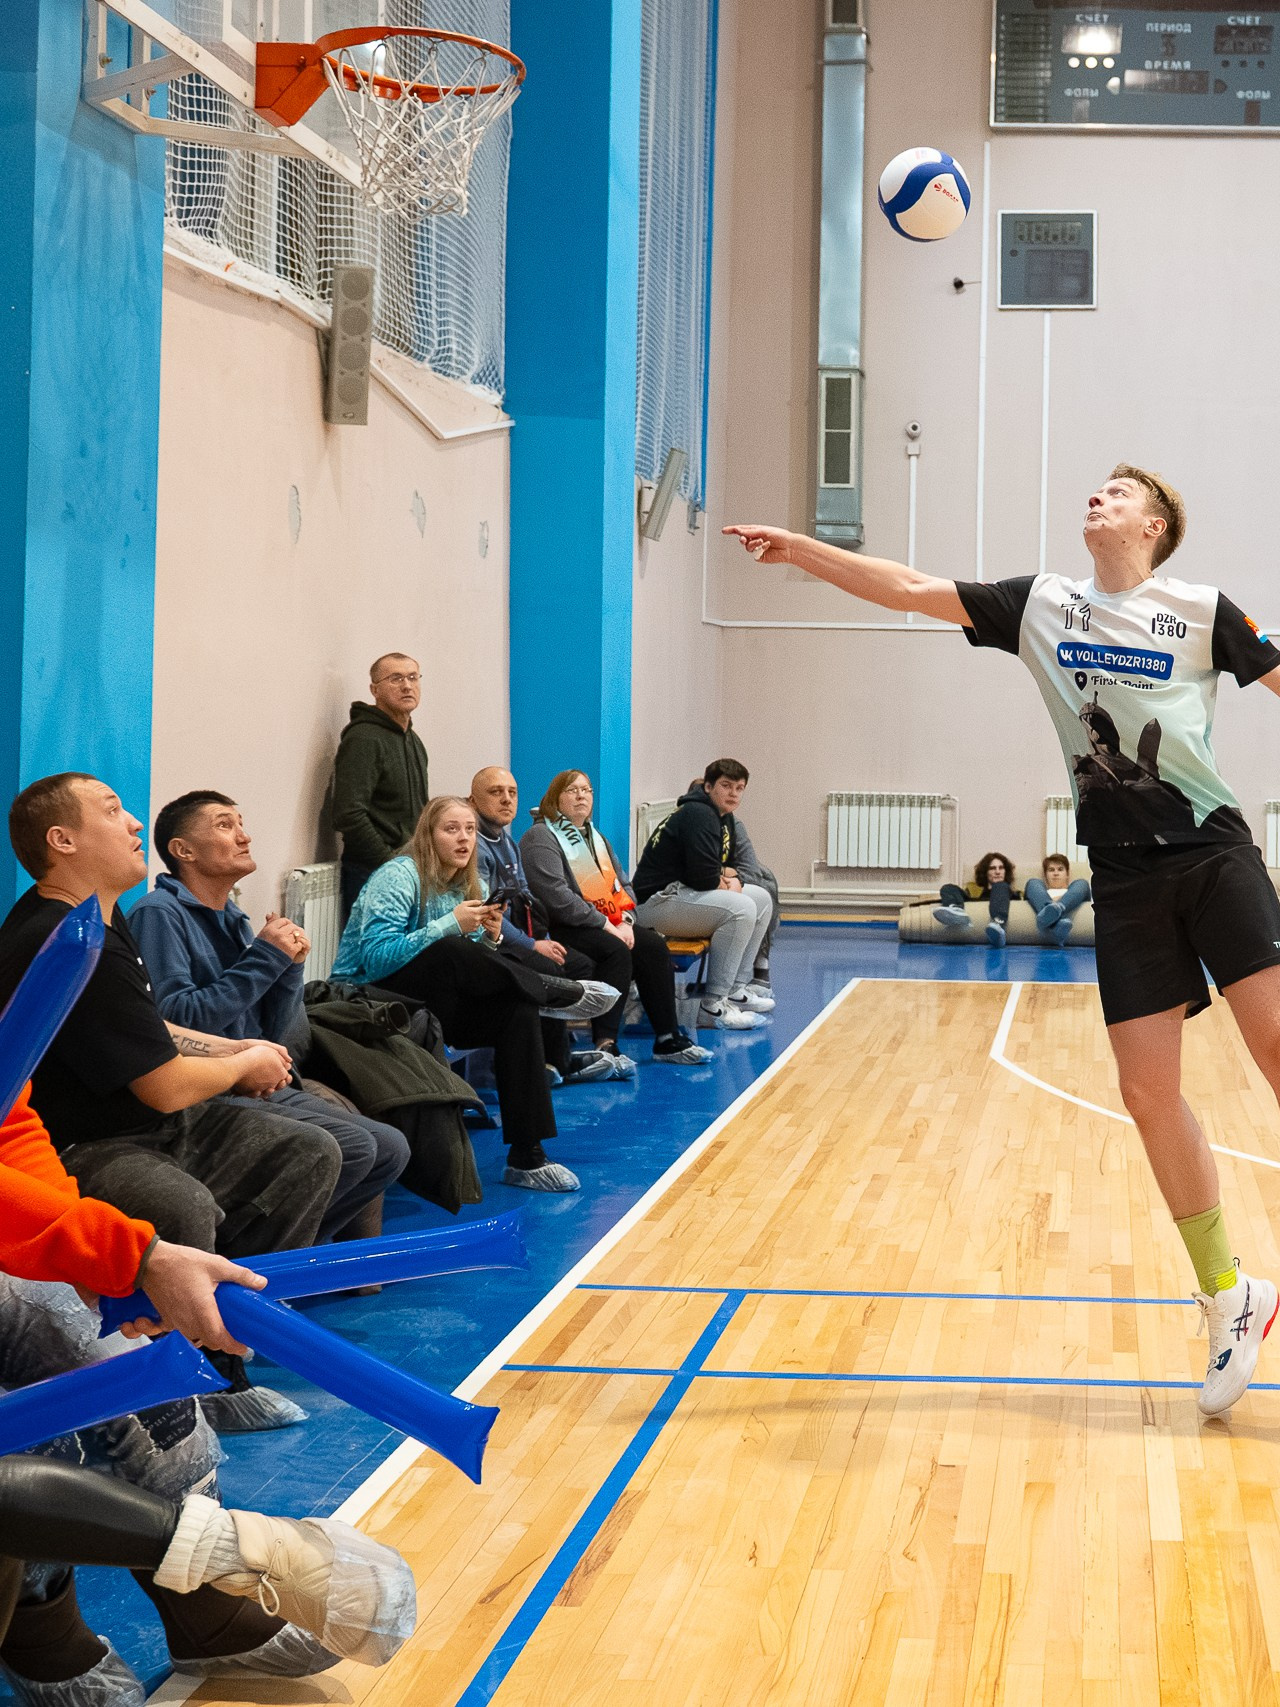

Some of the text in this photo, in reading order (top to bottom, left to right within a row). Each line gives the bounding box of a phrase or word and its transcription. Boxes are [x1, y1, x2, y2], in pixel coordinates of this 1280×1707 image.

[1146, 23, 1192, 34] ПЕРИОД
[1145, 60, 1191, 71] ВРЕМЯ
[1156, 613, 1176, 624] DZR
[1151, 617, 1187, 639] 1380
[1076, 650, 1167, 673] VOLLEYDZR1380
